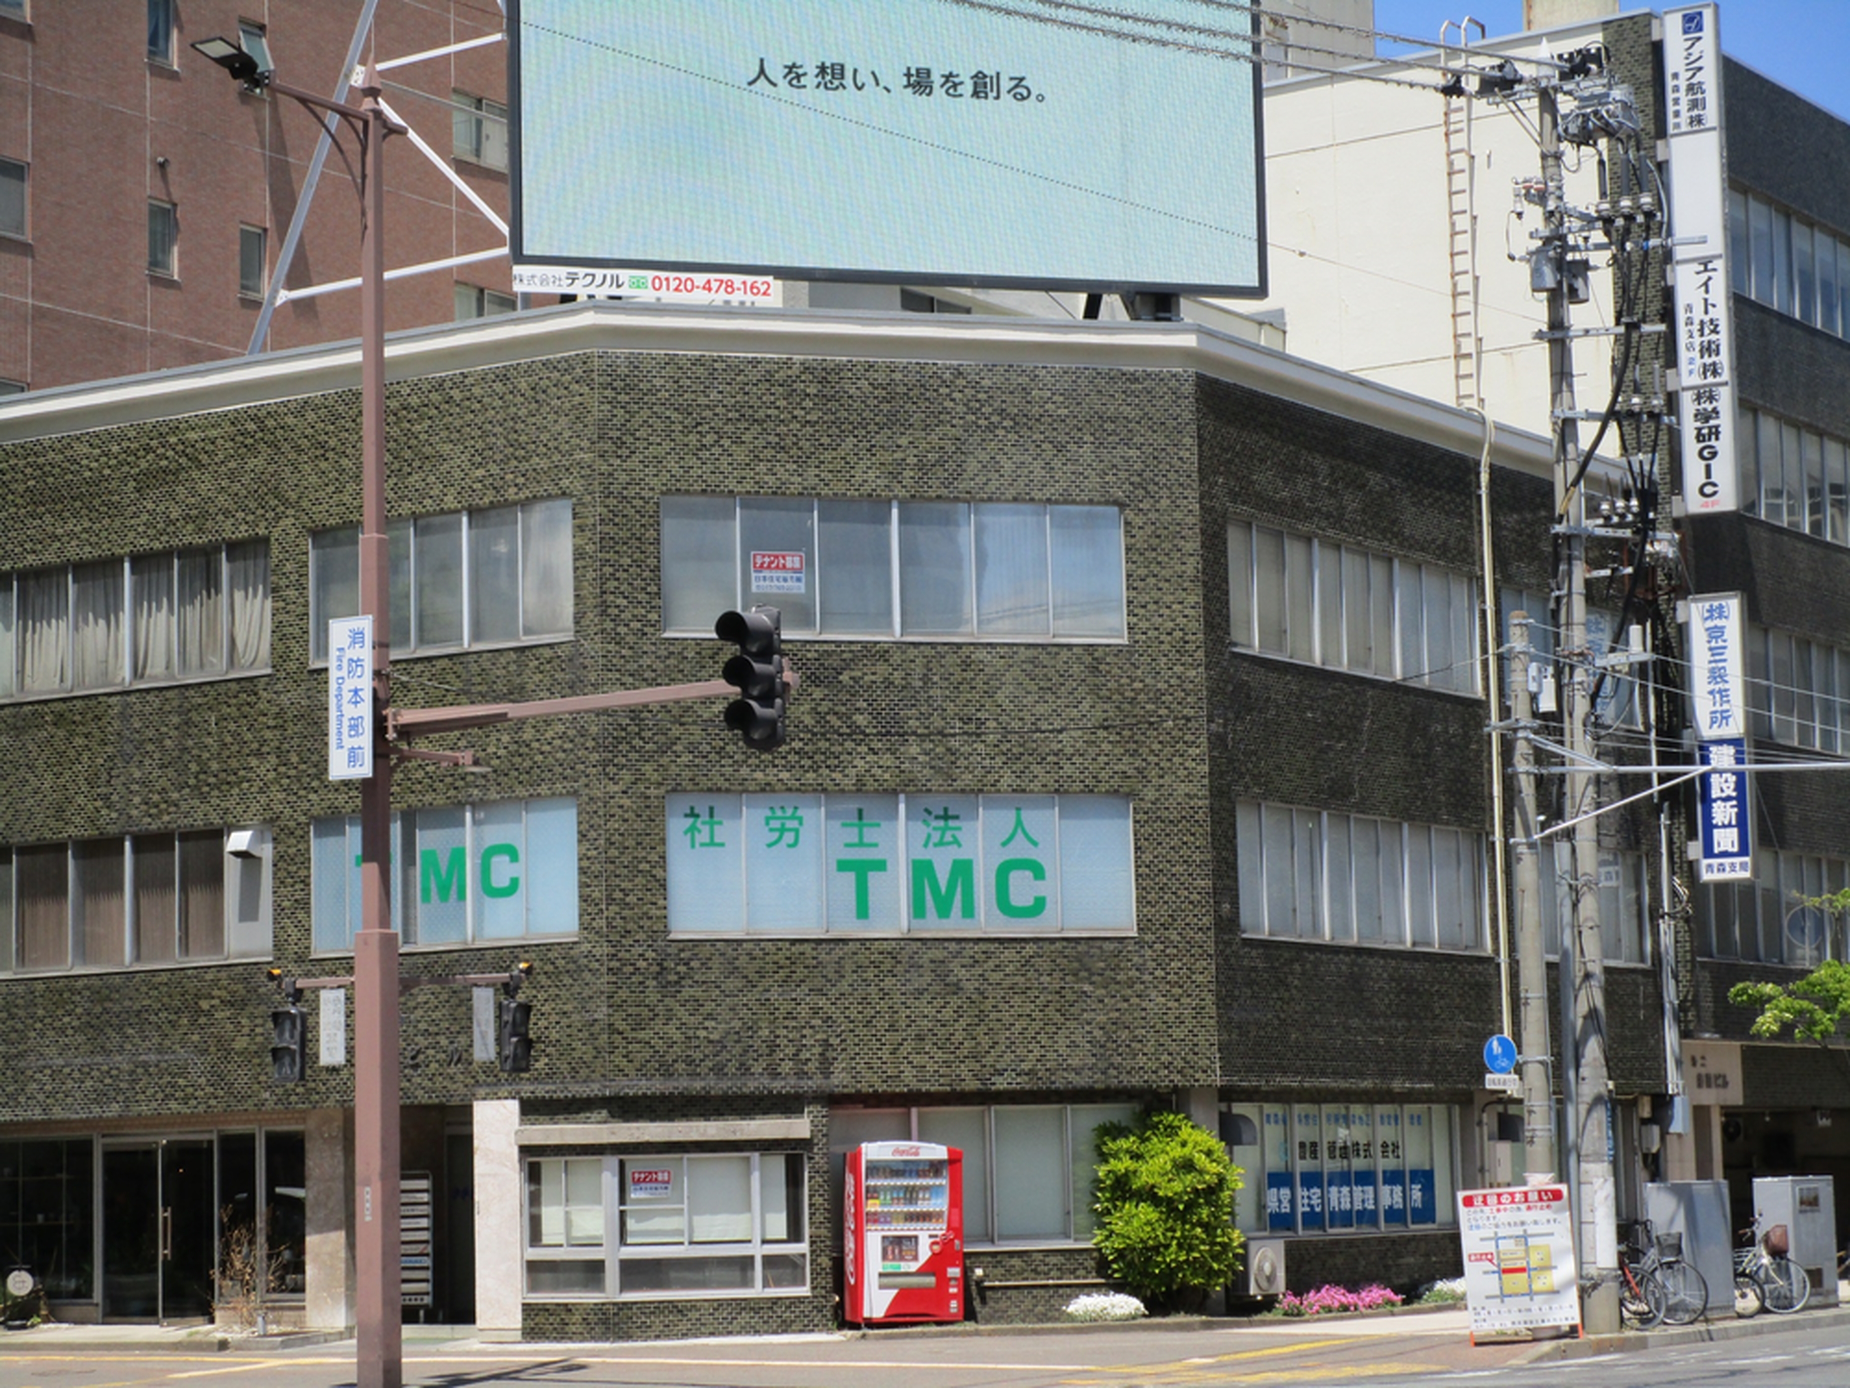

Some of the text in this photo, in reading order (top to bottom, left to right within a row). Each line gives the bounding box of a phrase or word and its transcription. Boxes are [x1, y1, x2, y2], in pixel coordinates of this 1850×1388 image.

[746, 58, 1046, 103] 人を想い、場を創る。
[651, 275, 772, 297] 0120-478-162
[335, 647, 345, 750] Fire Department
[347, 626, 366, 769] 消防本部前
[683, 805, 1041, 849] 社労士法人
[1709, 743, 1739, 855] 建設新聞
[355, 842, 520, 904] MC
[835, 857, 1047, 920] TMC
[1705, 860, 1748, 875] 青森支局
